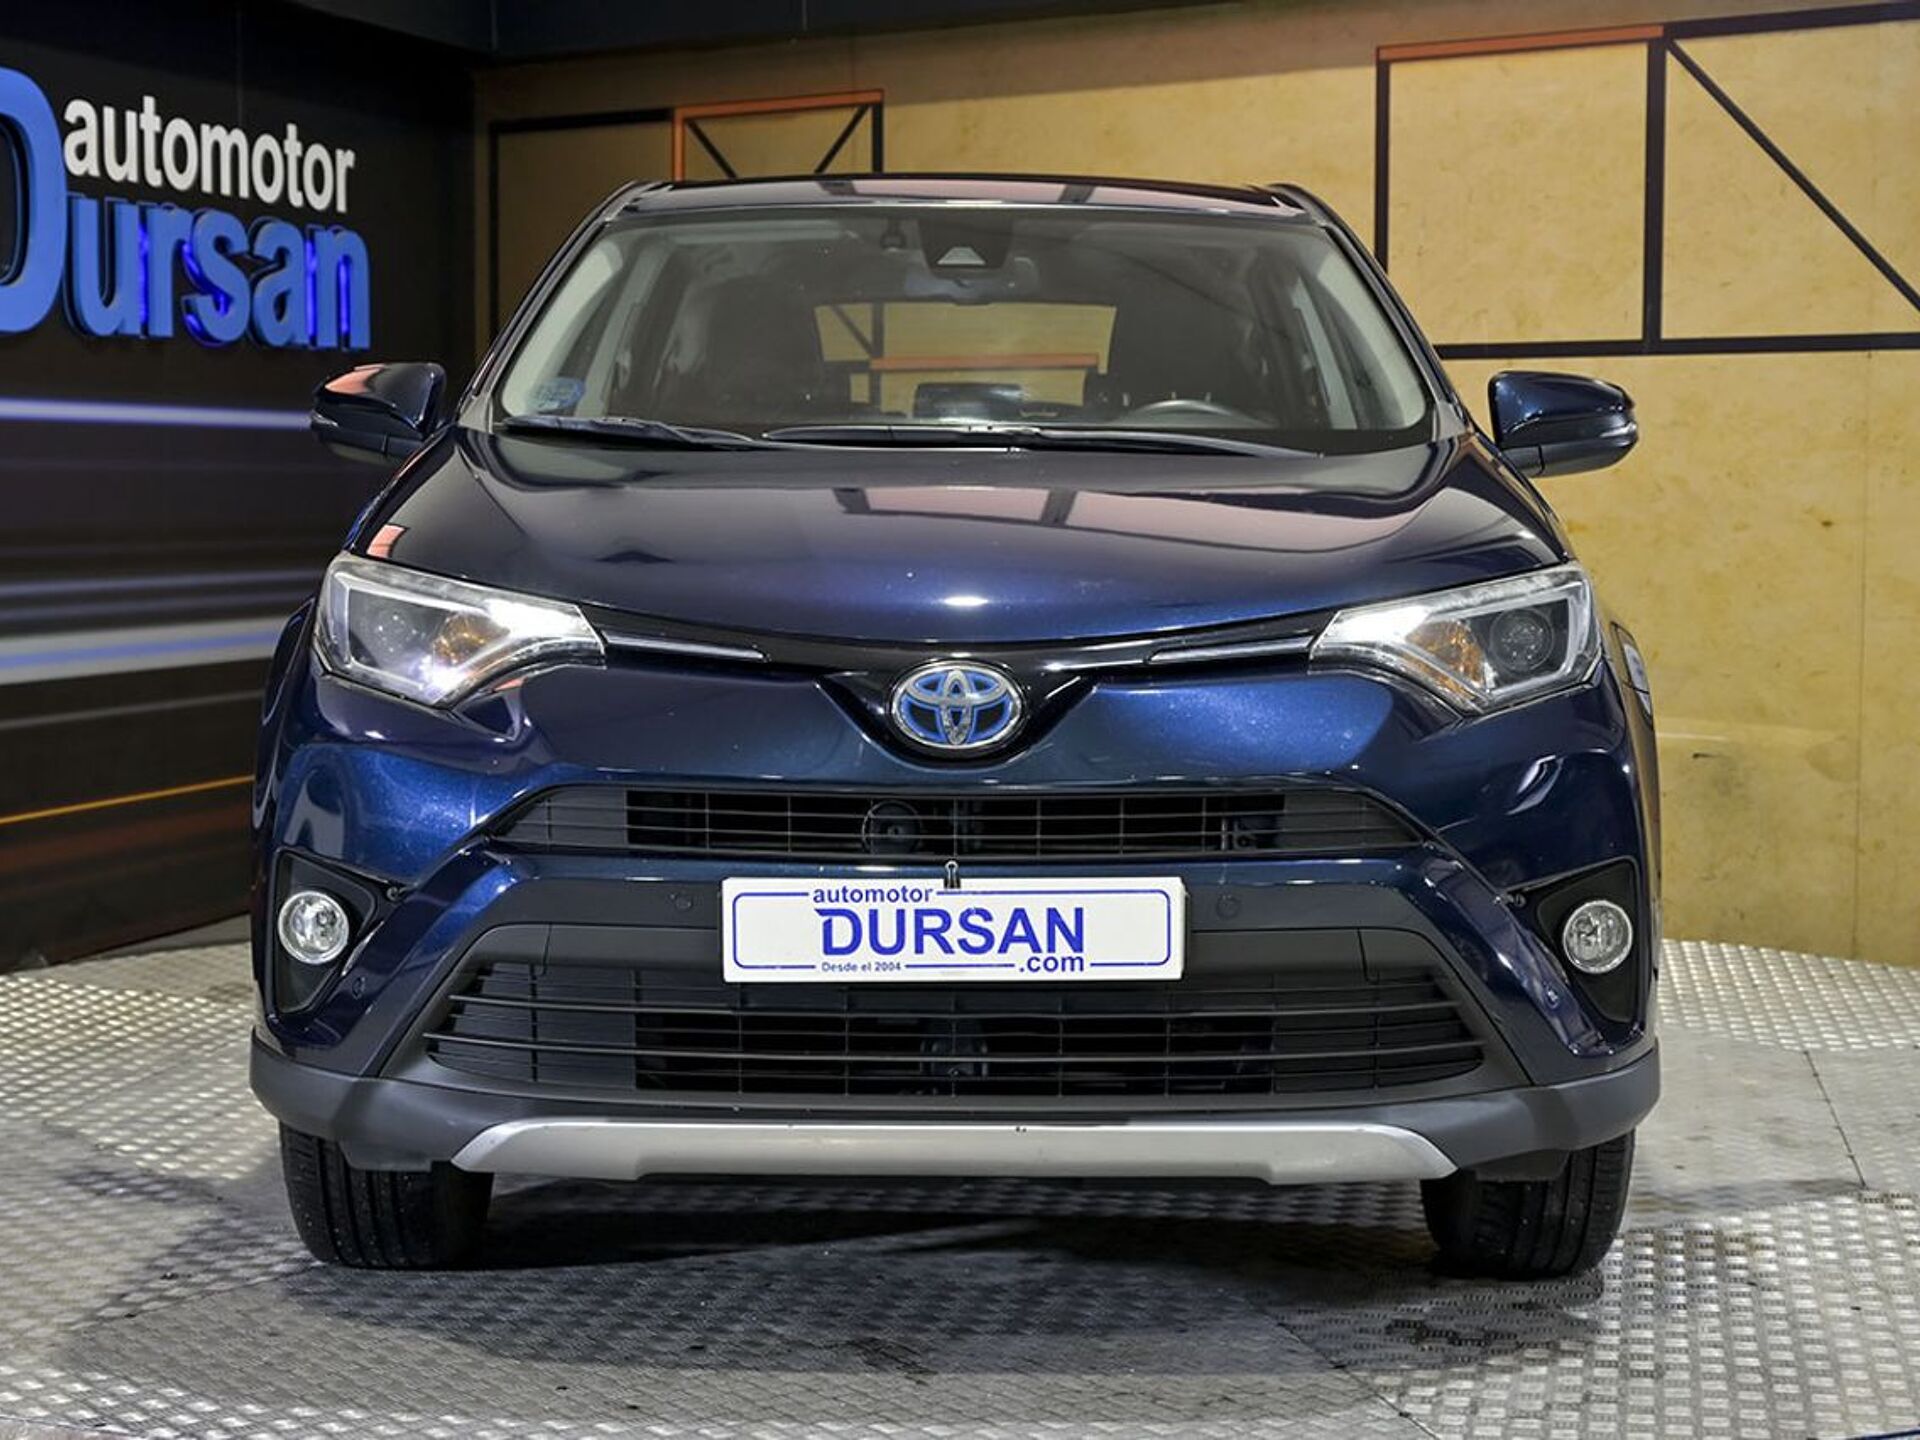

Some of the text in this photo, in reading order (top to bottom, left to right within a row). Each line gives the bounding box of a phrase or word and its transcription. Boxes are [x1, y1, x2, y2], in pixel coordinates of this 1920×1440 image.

[63, 95, 356, 213] automotor
[812, 885, 933, 903] automotor
[814, 907, 1084, 956] DURSAN
[821, 962, 901, 972] Desde el 2004
[1019, 956, 1084, 973] .com
